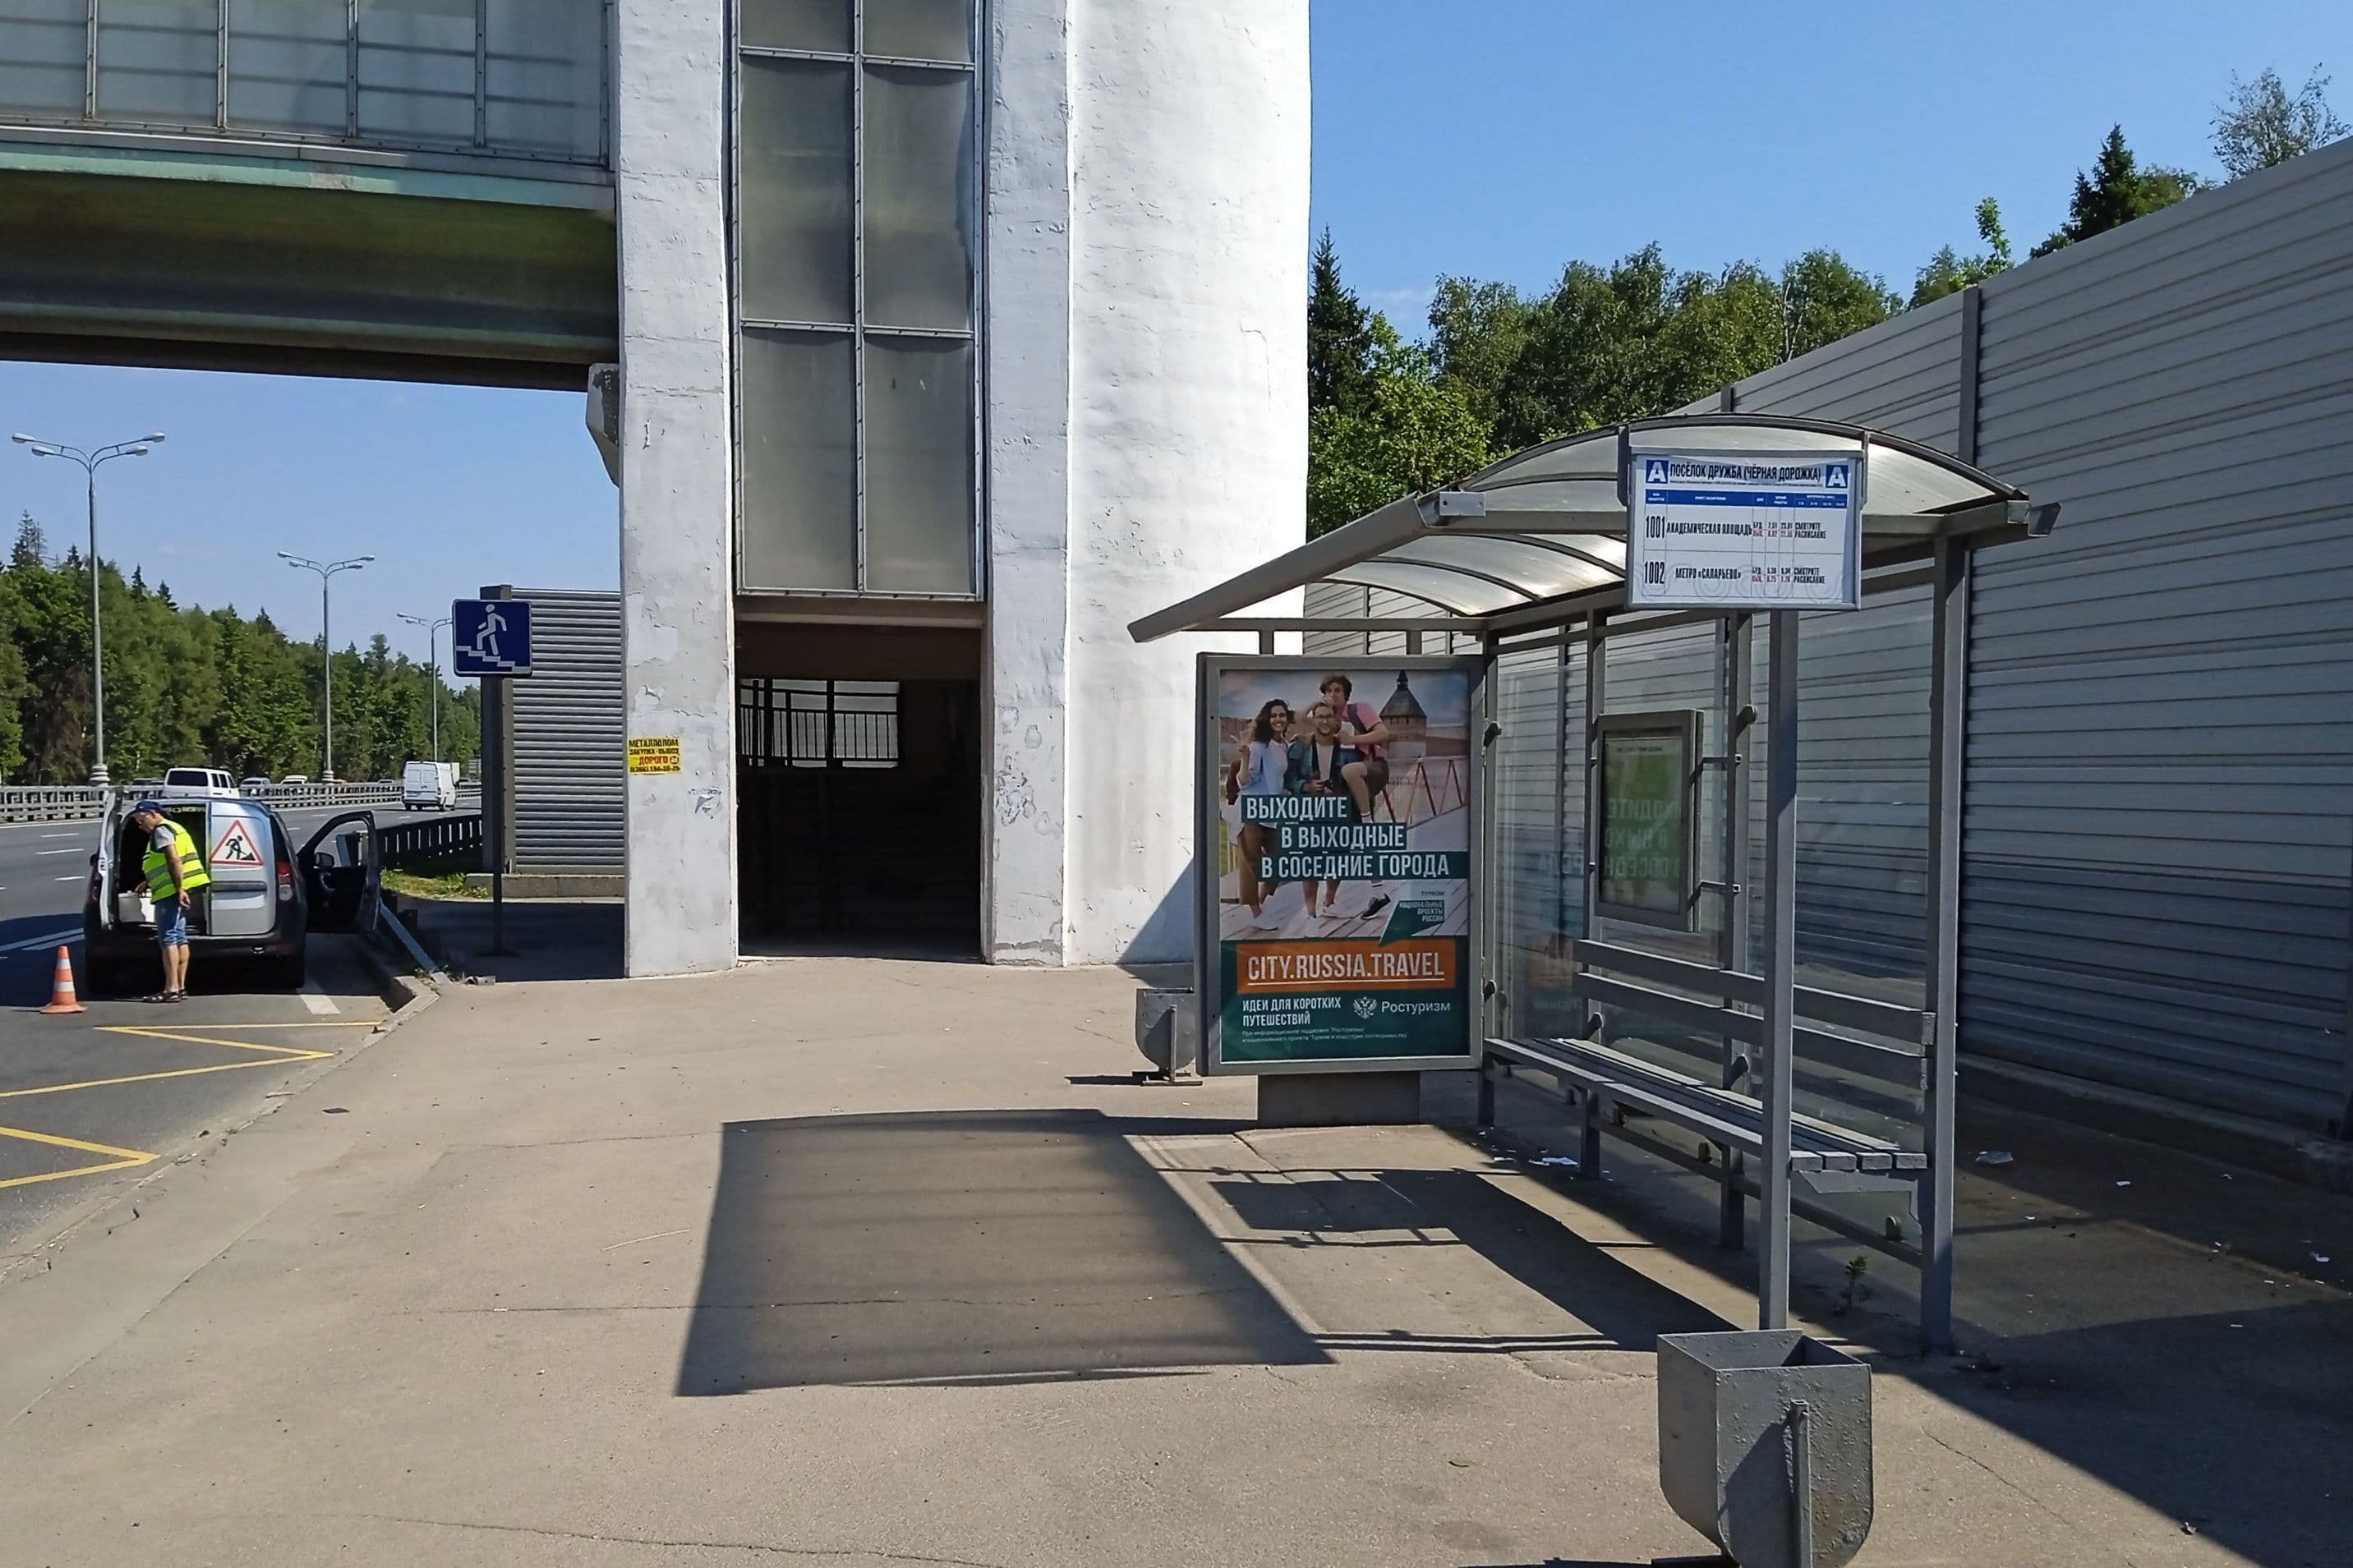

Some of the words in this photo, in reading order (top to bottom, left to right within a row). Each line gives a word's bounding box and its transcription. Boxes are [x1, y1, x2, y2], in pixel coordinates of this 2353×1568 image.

[1670, 462, 1706, 477] ПОСЁЛОК
[1708, 465, 1741, 480] ДРУЖБА
[1743, 464, 1776, 481] (ЧЁРНАЯ
[1779, 467, 1821, 483] ДОРОЖКА)
[1646, 515, 1665, 539] 1001
[1667, 522, 1720, 535] АКАДЕМИЧЕСКАЯ
[1722, 523, 1752, 536] ПЛОЩАДЬ
[1645, 561, 1665, 584] 1002
[1676, 568, 1697, 578] МЕТРО
[1698, 568, 1741, 580] «САЛАРЬЕВО»
[629, 738, 679, 747] МЕТАЛЛОЛОМ
[639, 756, 668, 765] ДОРОГО
[1246, 797, 1347, 821] ВЫХОДИТЕ
[1281, 826, 1292, 848] В
[1298, 825, 1404, 850] ВЫХОДНЫЕ
[1261, 857, 1273, 878] В
[1278, 855, 1373, 880] СОСЕДНИЕ
[1379, 854, 1449, 878] ГОРОДА
[1248, 952, 1444, 981] CITY.RUSSIA.TRAVEL
[1242, 999, 1269, 1012] ИДЕИ
[1271, 998, 1292, 1012] ДЛЯ
[1293, 996, 1341, 1010] КОРОТКИХ
[1381, 1000, 1450, 1014] Ростуризм
[1243, 1011, 1310, 1028] ПУТЕШЕСТВИЙ
